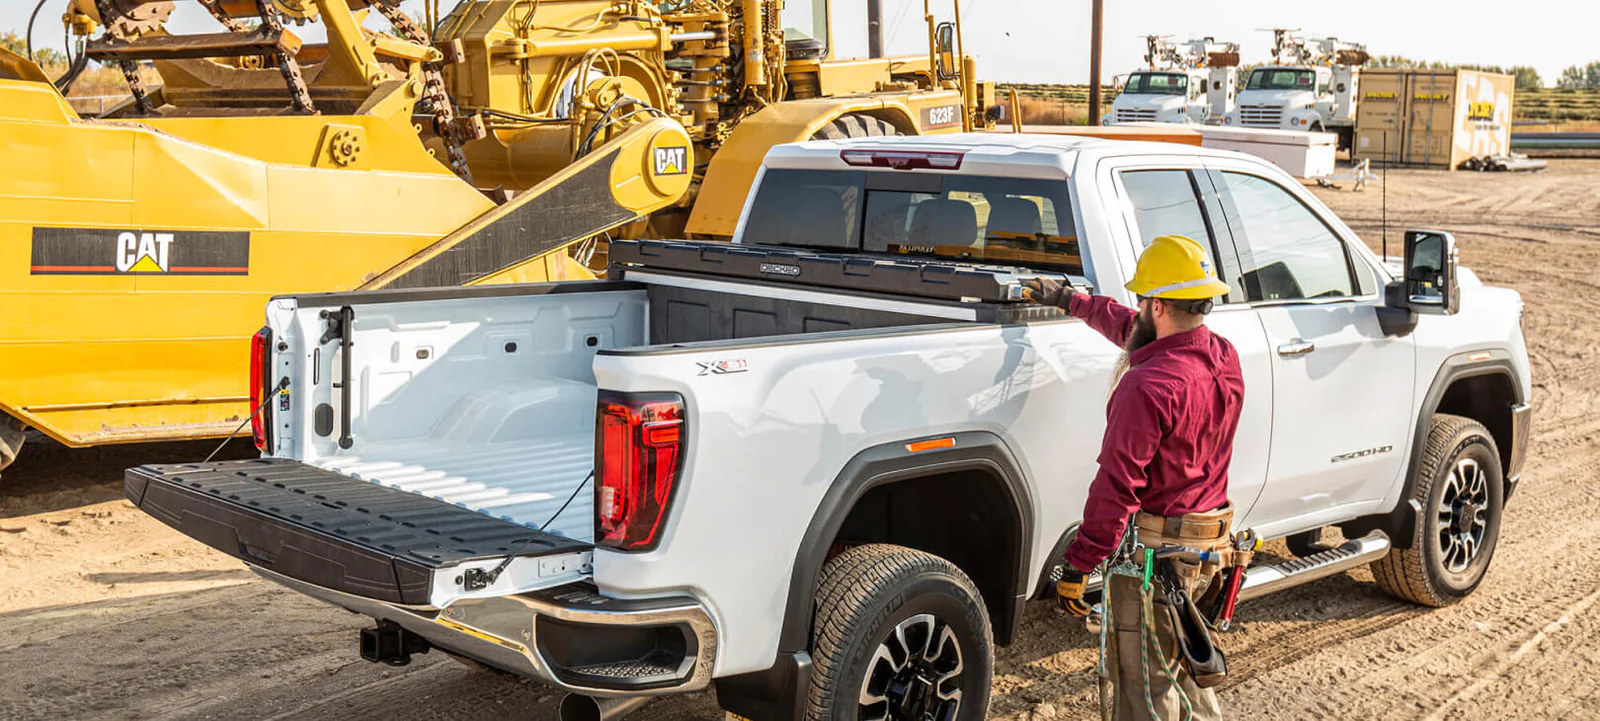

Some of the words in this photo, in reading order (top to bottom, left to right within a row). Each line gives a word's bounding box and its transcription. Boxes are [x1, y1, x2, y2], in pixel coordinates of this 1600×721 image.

[930, 106, 954, 125] 623F
[656, 148, 685, 173] CAT
[116, 232, 174, 272] CAT
[760, 263, 800, 276] DECKED
[1331, 449, 1371, 463] 2500
[1372, 444, 1393, 455] HD
